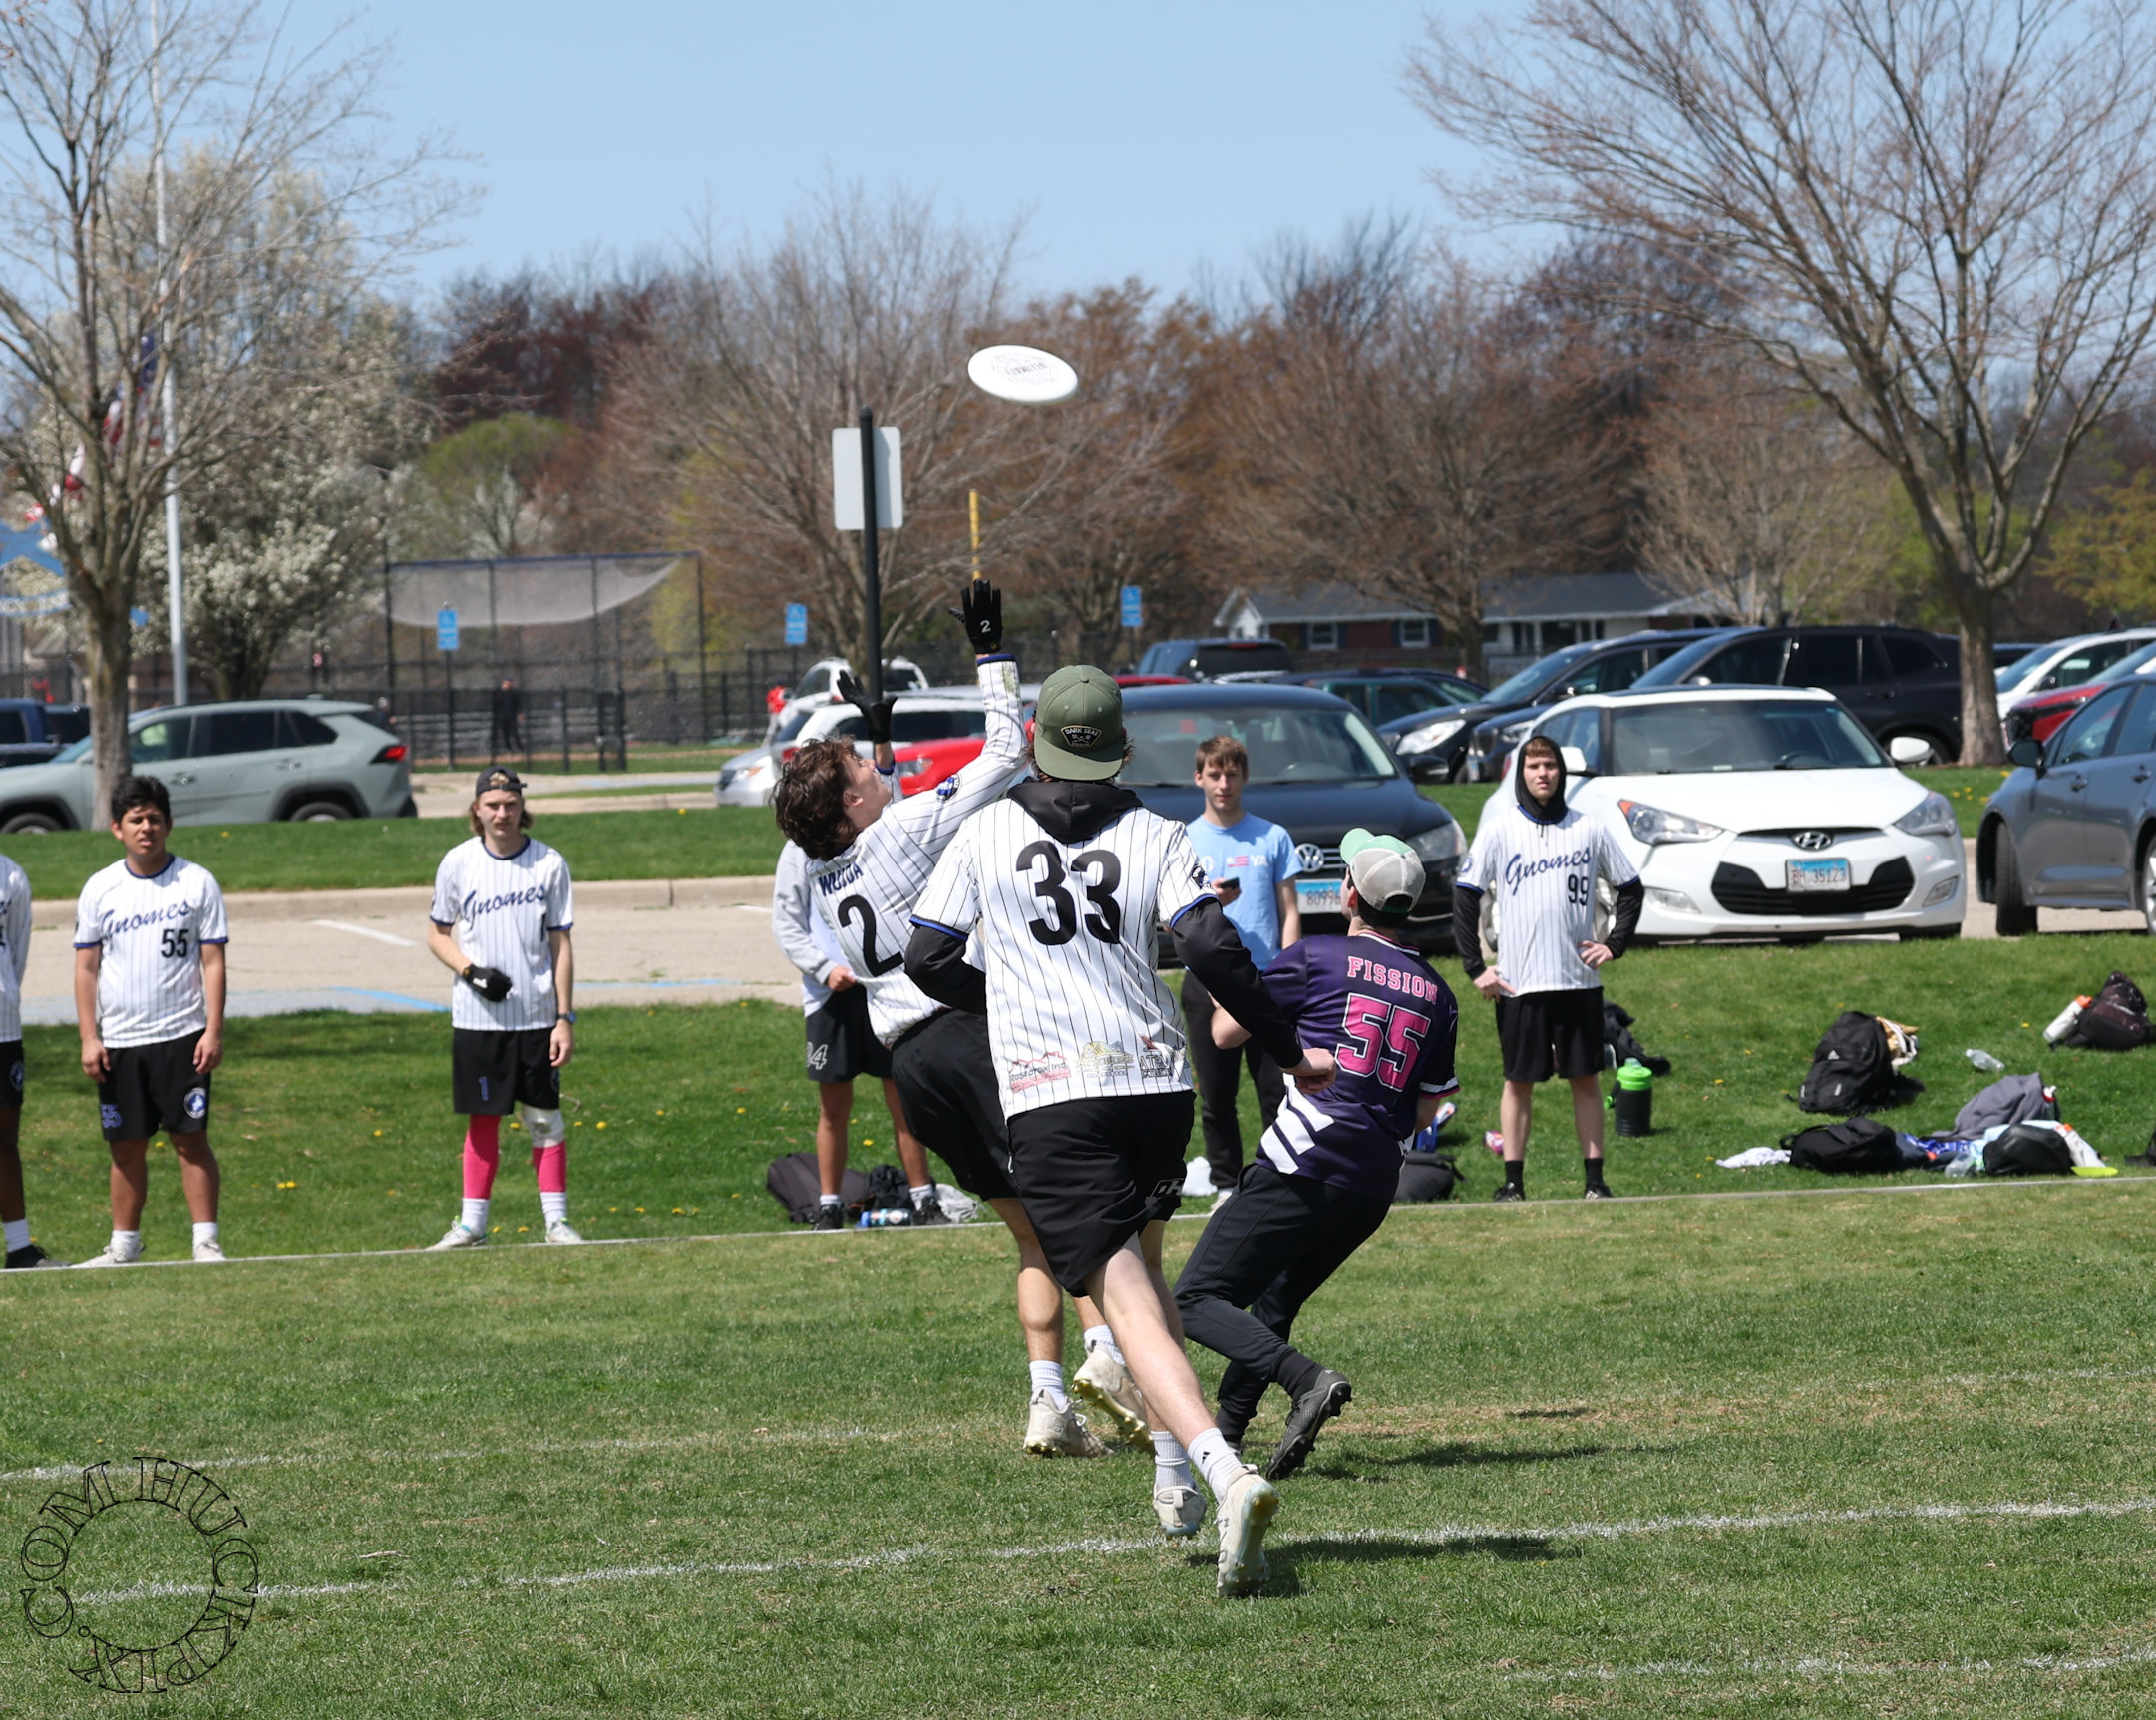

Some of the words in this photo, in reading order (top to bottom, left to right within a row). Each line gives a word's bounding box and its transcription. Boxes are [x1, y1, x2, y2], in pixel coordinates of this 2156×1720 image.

[979, 619, 991, 633] 2
[1015, 840, 1122, 946] 33
[1505, 847, 1592, 896] Gnomes
[1568, 874, 1589, 906] 99
[101, 899, 190, 945] Gnomes
[463, 884, 546, 931] Gnomes
[161, 928, 189, 958] 55
[838, 894, 904, 977] 2
[1347, 955, 1438, 1005] FISSION
[1334, 992, 1431, 1093] 55
[479, 1076, 490, 1101] 1
[100, 1104, 123, 1129] 55
